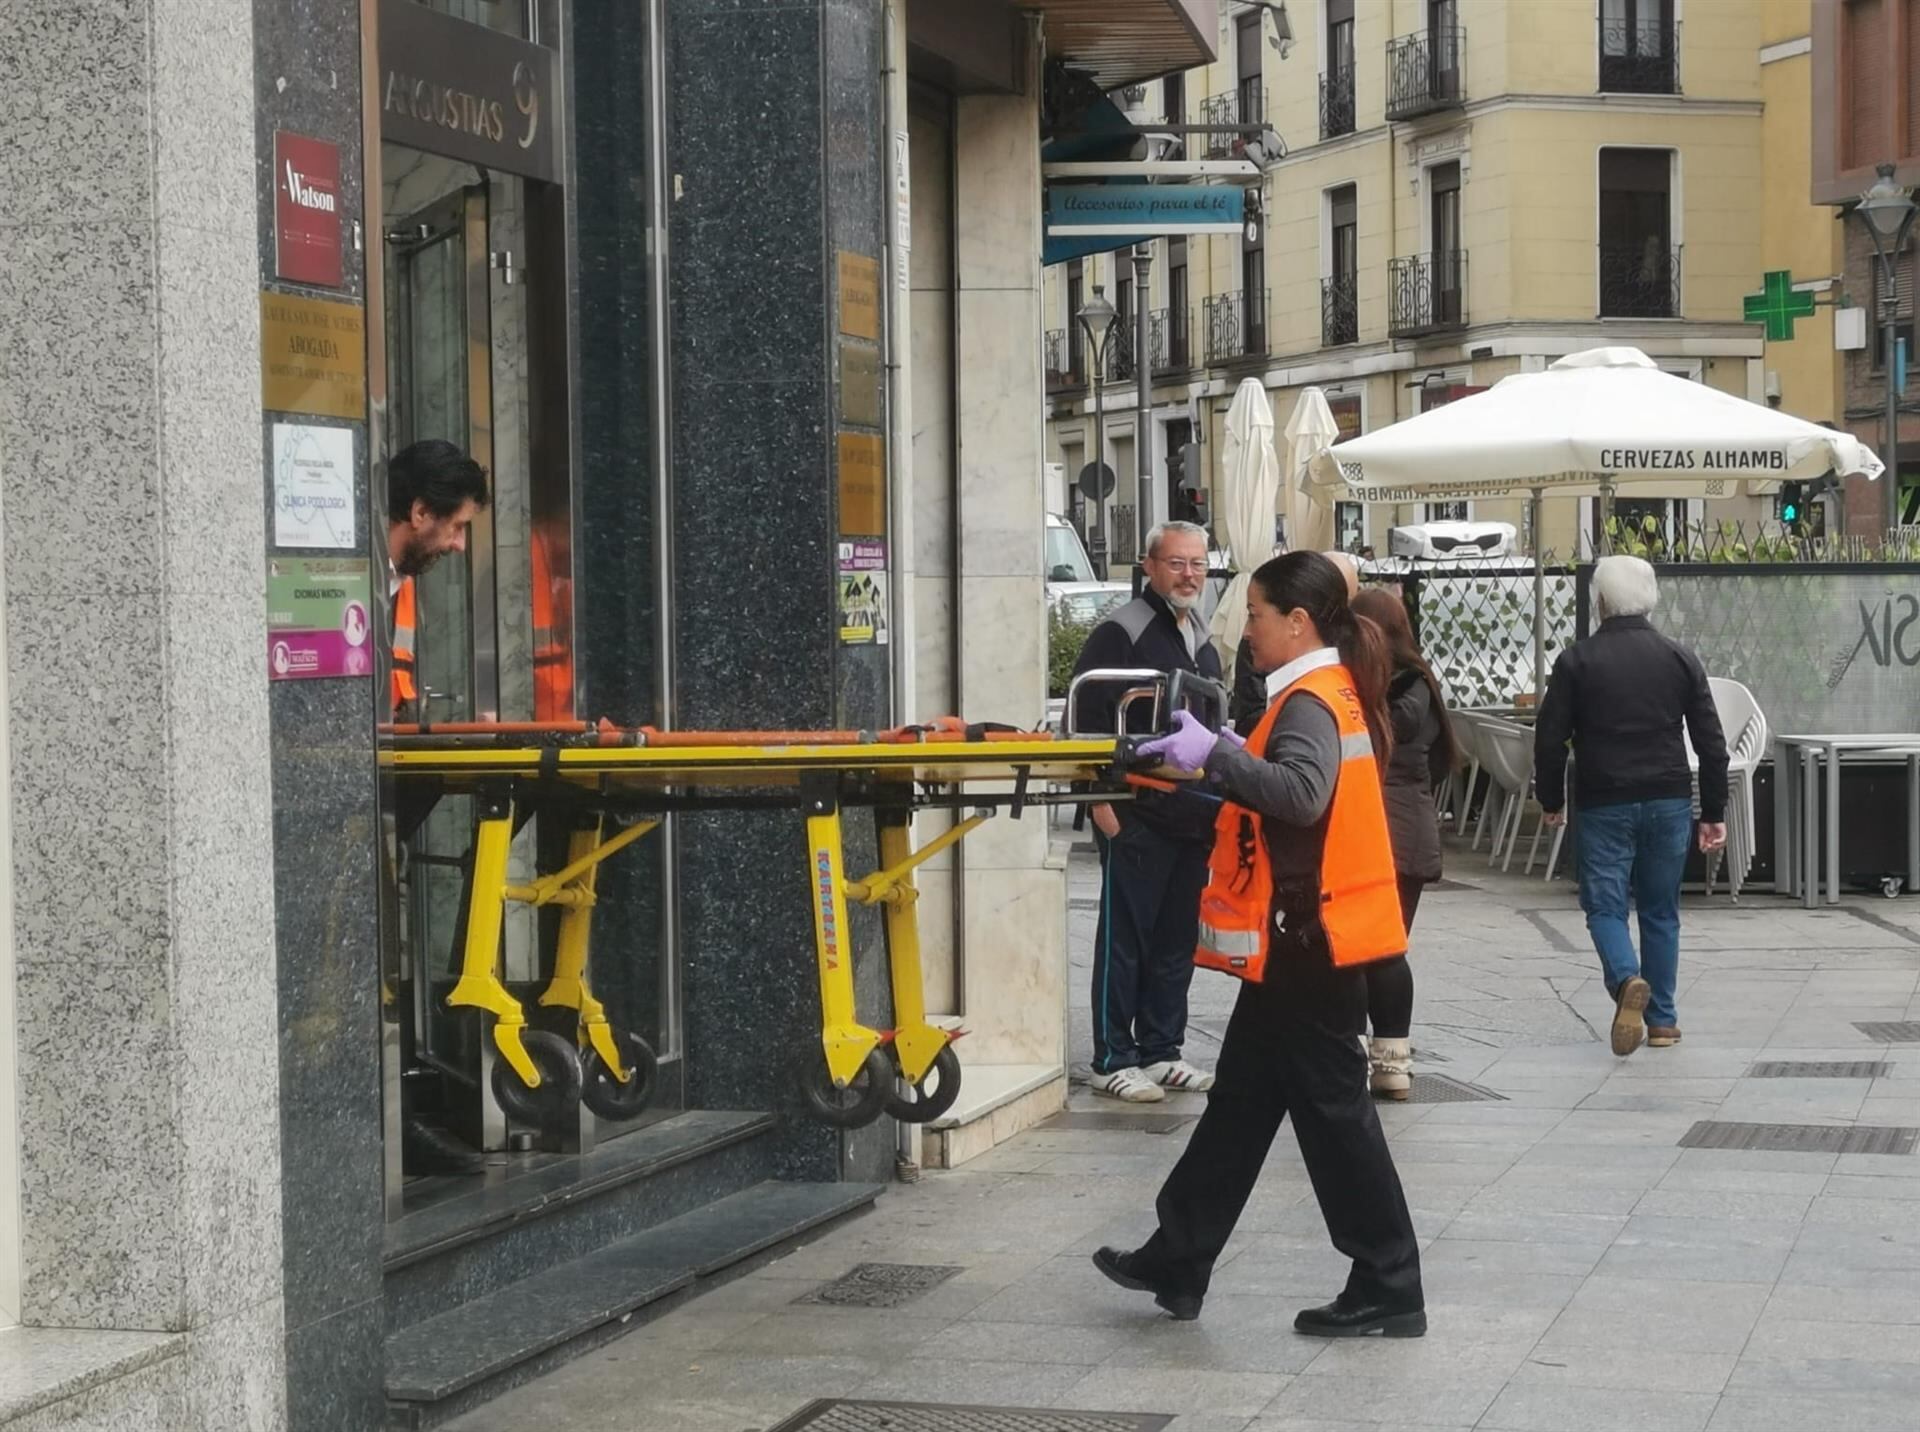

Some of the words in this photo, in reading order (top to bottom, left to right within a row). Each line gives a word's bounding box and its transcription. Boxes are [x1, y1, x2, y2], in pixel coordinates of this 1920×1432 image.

[384, 70, 504, 143] ANGUSTIAS
[512, 61, 539, 149] 9
[282, 158, 335, 212] Watson
[1064, 195, 1144, 211] Accesorios
[1149, 199, 1188, 214] para
[1193, 195, 1208, 210] el
[1212, 194, 1226, 210] té
[288, 336, 340, 360] ABOGADA
[1601, 449, 1695, 469] CERVEZAS
[1702, 450, 1788, 470] ALHAMB
